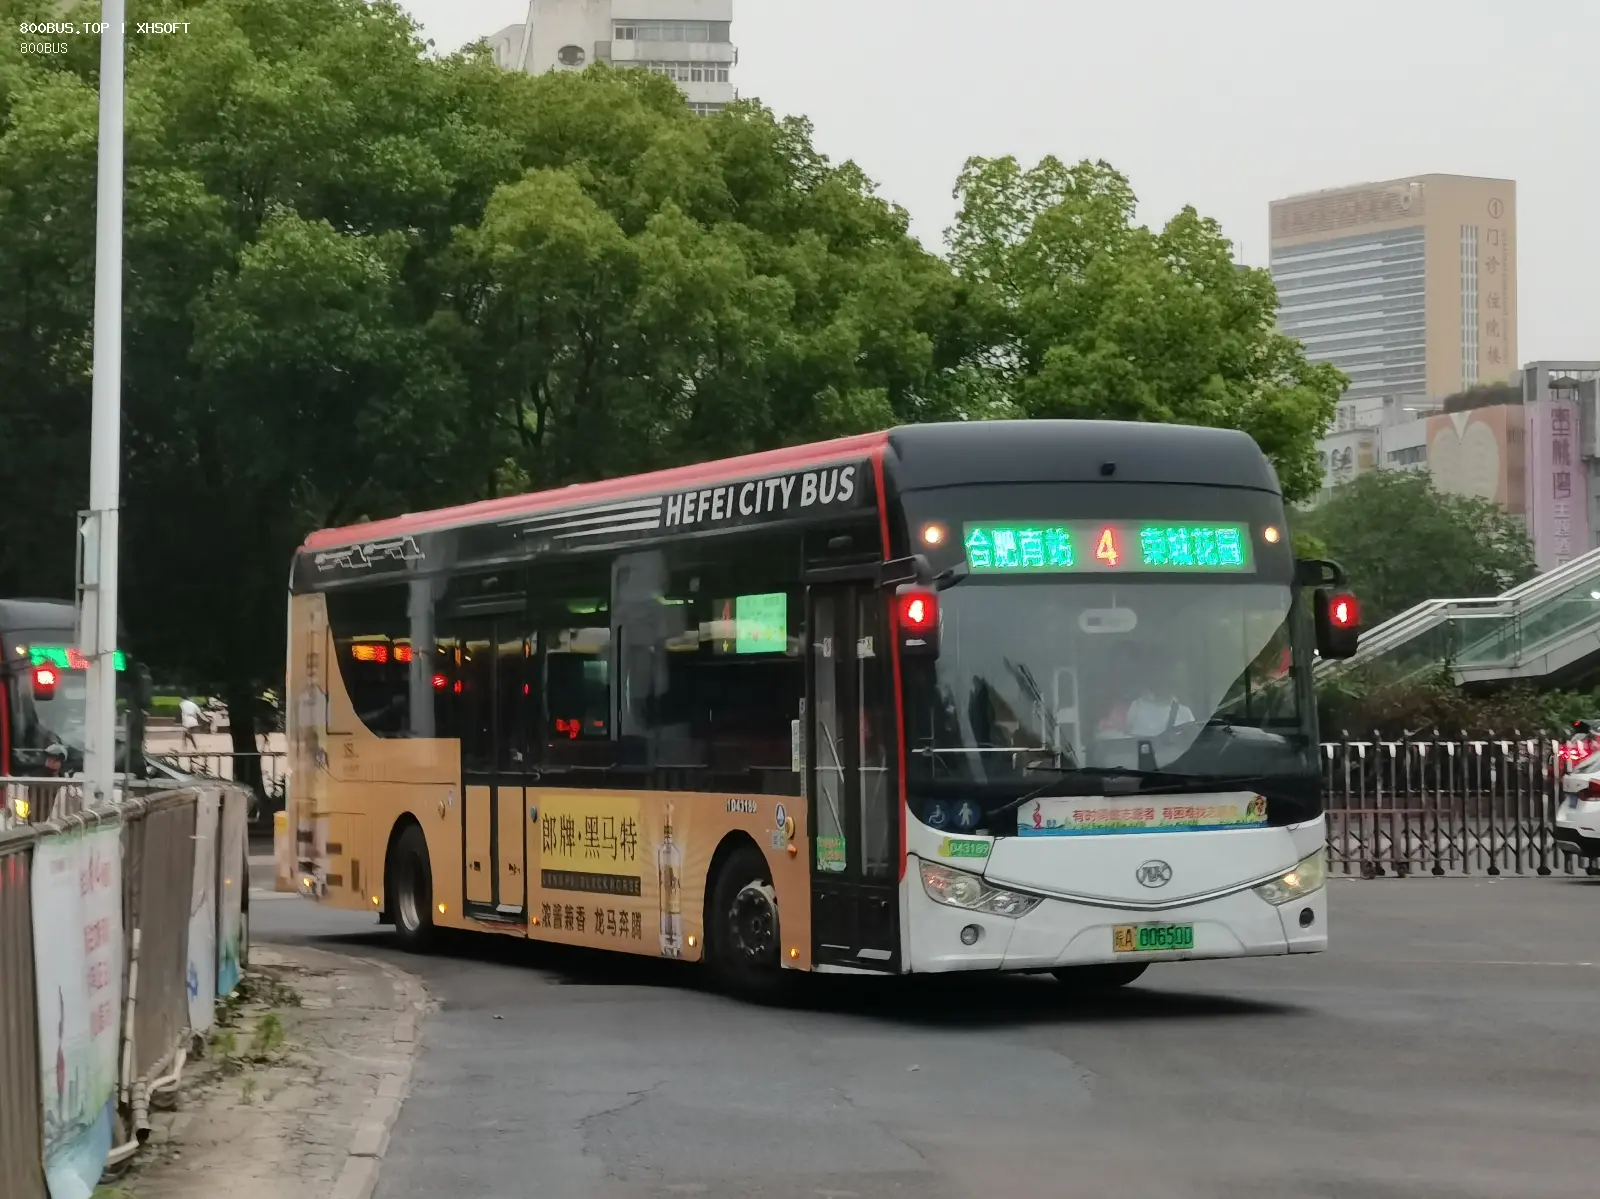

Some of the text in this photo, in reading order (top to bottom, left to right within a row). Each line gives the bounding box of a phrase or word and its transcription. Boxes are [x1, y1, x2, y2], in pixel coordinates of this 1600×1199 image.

[665, 466, 855, 527] HEFEI CITY BUS
[965, 527, 1074, 568] 合肥南站
[1096, 527, 1119, 566] 4
[542, 812, 638, 862] 郎牌·黑马特
